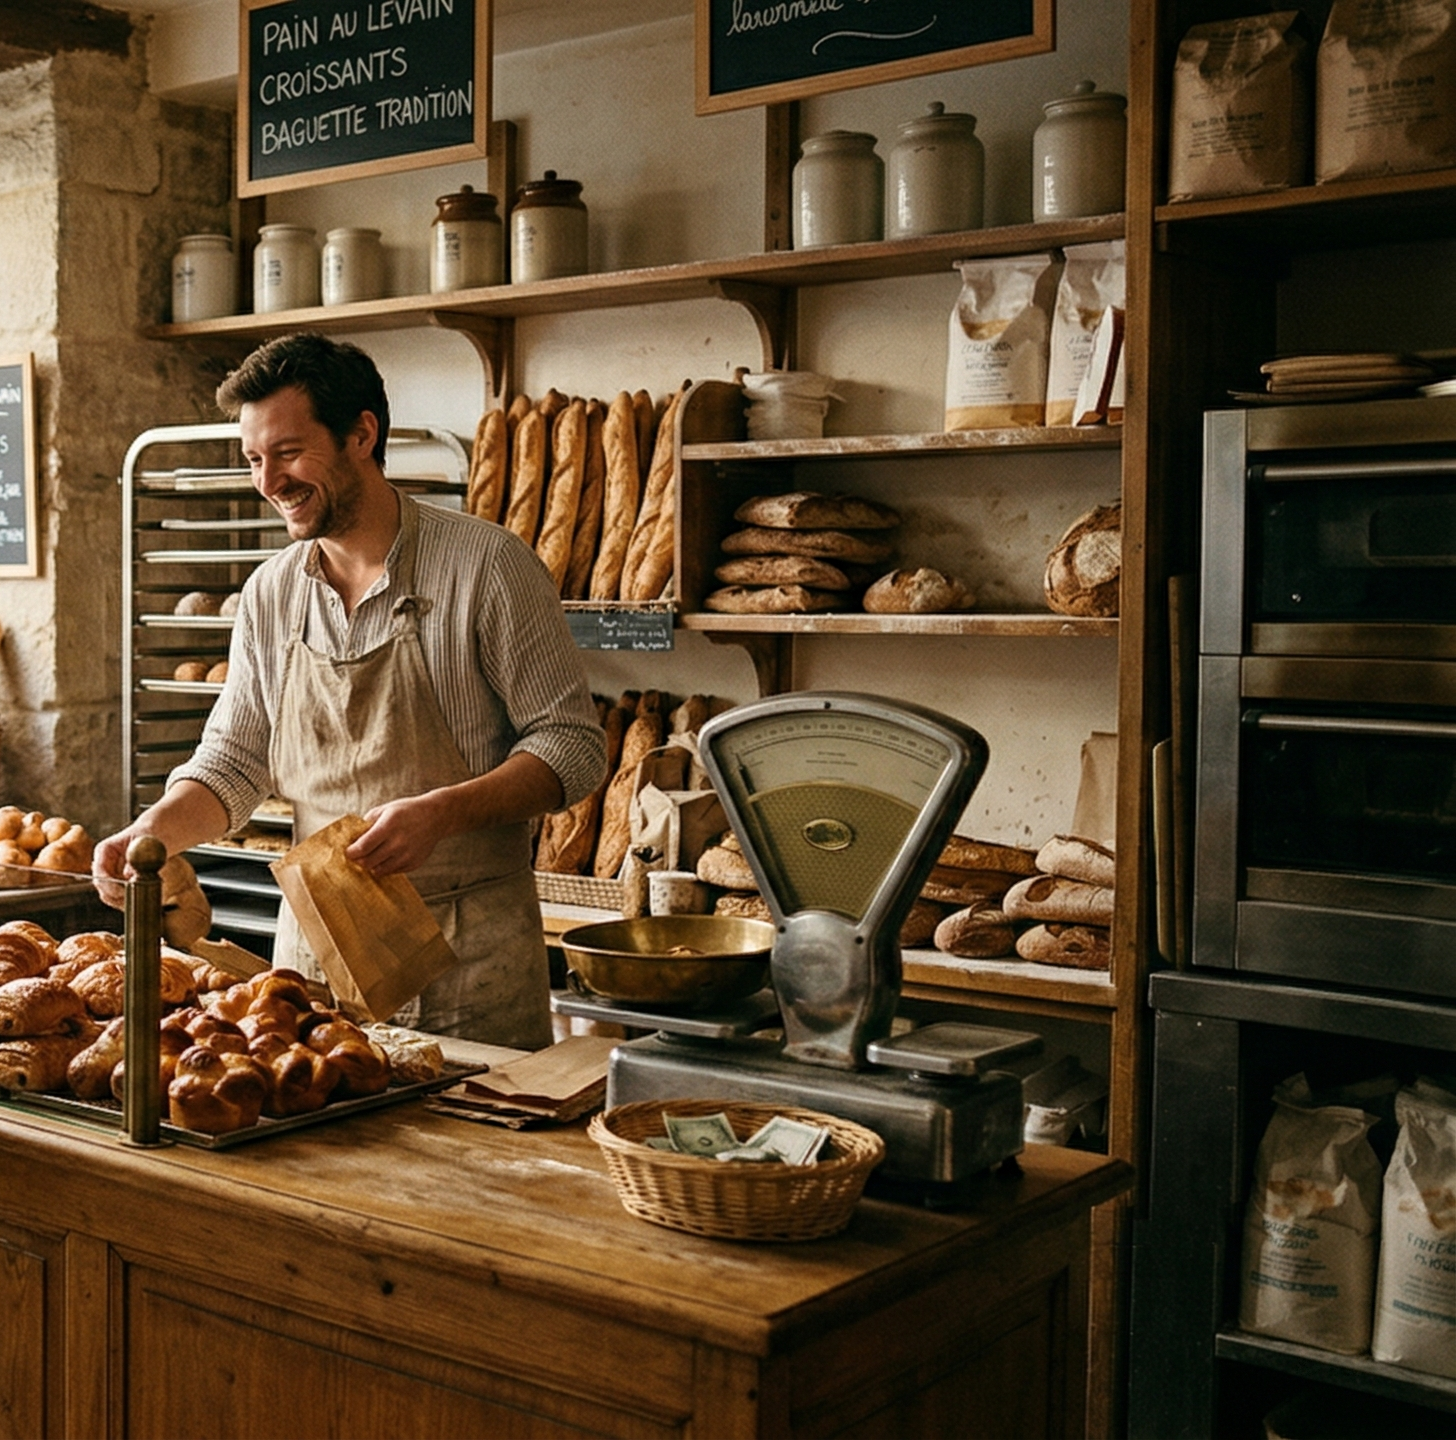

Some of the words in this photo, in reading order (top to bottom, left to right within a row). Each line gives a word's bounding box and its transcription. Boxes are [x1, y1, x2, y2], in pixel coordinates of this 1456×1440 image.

[263, 14, 318, 56] PAIN
[329, 10, 358, 42] AU
[367, 0, 453, 32] LEVAIN
[259, 46, 408, 106] CROISSANTS
[261, 104, 367, 155] BAGUETTE
[375, 80, 473, 130] TRADITION
